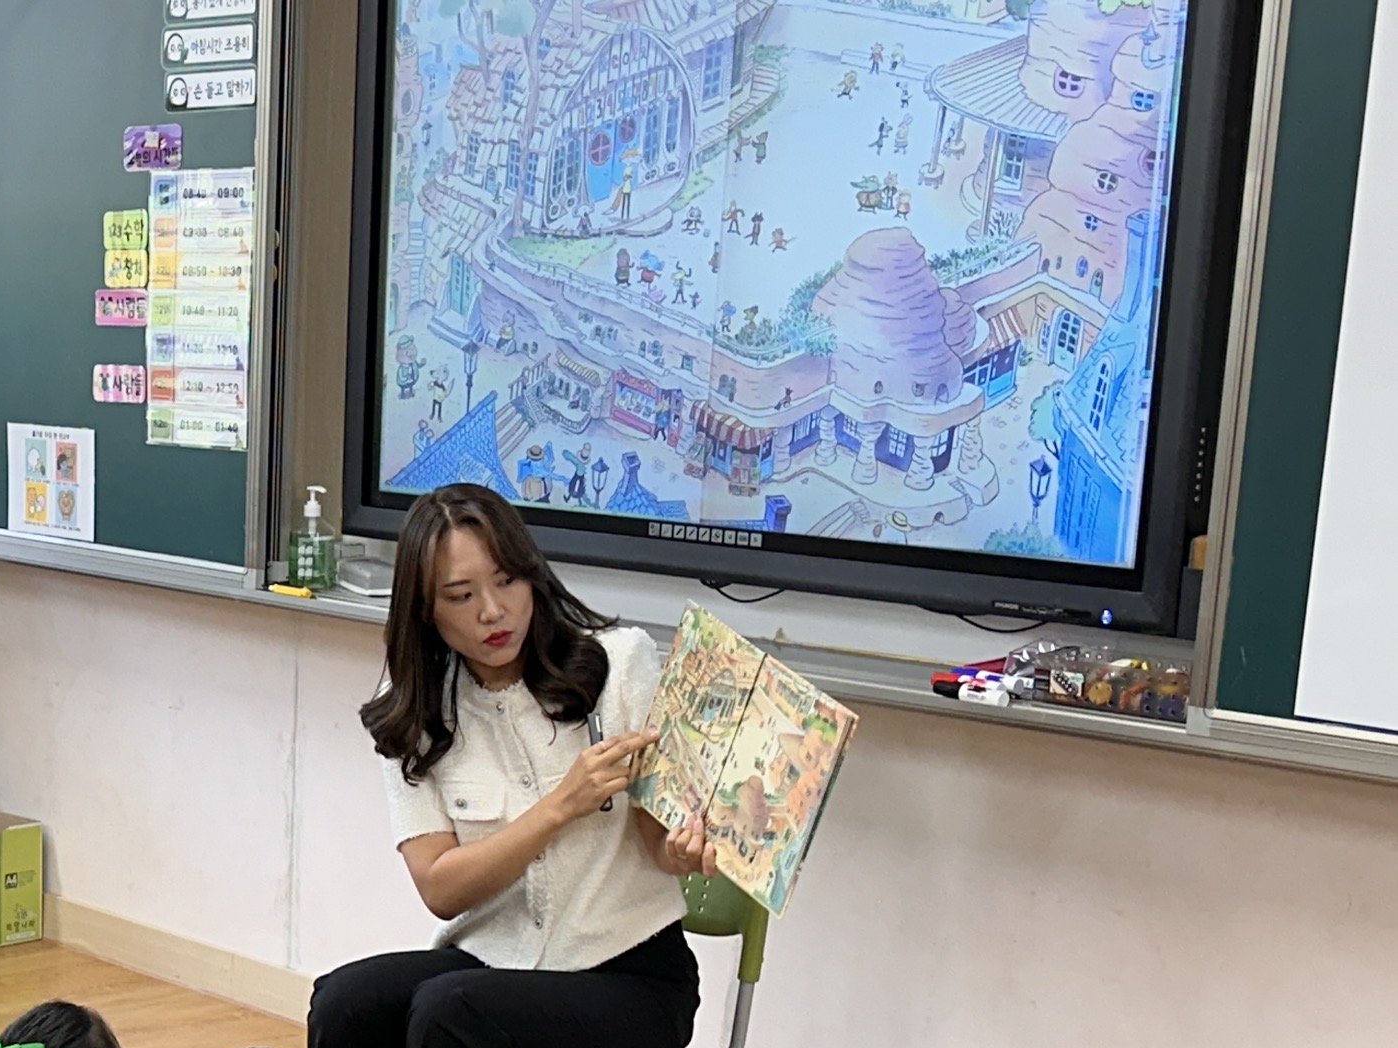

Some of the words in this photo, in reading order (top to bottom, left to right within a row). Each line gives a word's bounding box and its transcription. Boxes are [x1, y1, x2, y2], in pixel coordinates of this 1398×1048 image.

[190, 37, 222, 55] 아침시간
[224, 35, 250, 52] 조용히
[193, 84, 203, 100] 손
[205, 82, 224, 99] 들고
[226, 78, 253, 98] 말하기
[217, 187, 245, 198] 09:00
[123, 218, 145, 242] 수학
[112, 369, 142, 397] 사람들
